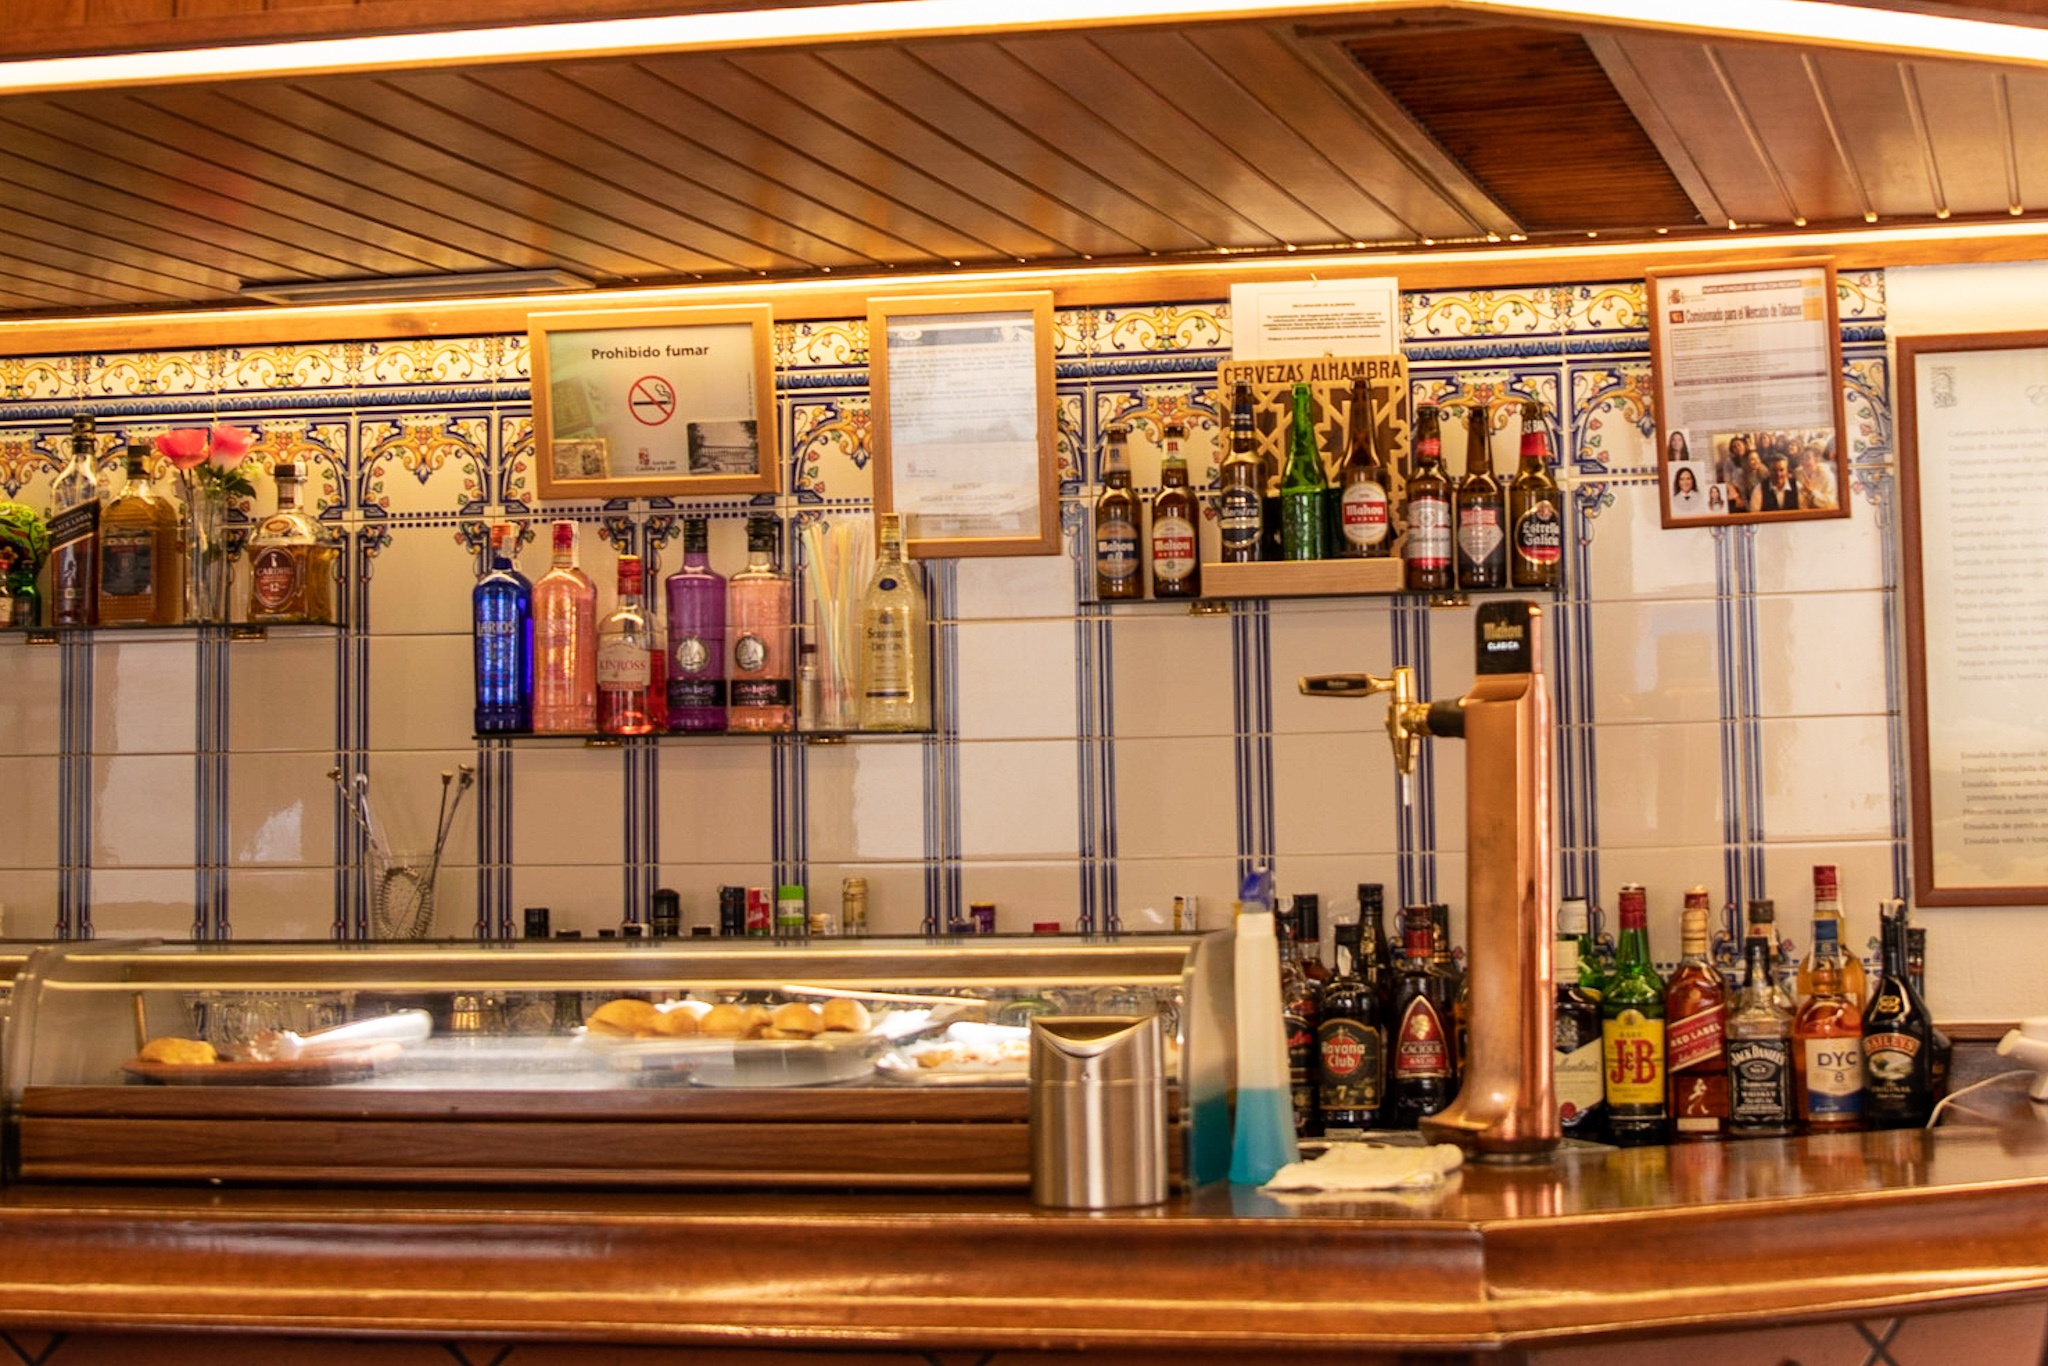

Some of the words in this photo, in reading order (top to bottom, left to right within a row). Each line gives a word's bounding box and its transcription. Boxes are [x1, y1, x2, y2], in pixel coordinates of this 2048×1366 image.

[591, 345, 661, 360] Prohibido
[665, 344, 710, 358] fumar
[1223, 363, 1304, 386] CERVEZAS
[1310, 360, 1402, 382] ALHAMBRA
[1346, 503, 1384, 516] Mahou
[1522, 521, 1560, 534] Estrella
[1098, 541, 1134, 553] Mahou
[1154, 539, 1190, 551] Mahou
[1523, 533, 1560, 546] Galicia
[476, 620, 516, 637] LARIOS
[1483, 620, 1523, 639] Mahou
[1670, 1033, 1691, 1048] RED
[1690, 1022, 1722, 1041] LABEL
[1321, 1040, 1366, 1056] Havana
[1327, 1053, 1356, 1068] Club
[1730, 1048, 1752, 1067] JACK
[1817, 1051, 1858, 1068] DYC
[1834, 1071, 1845, 1083] 8
[1336, 1085, 1348, 1100] 7
